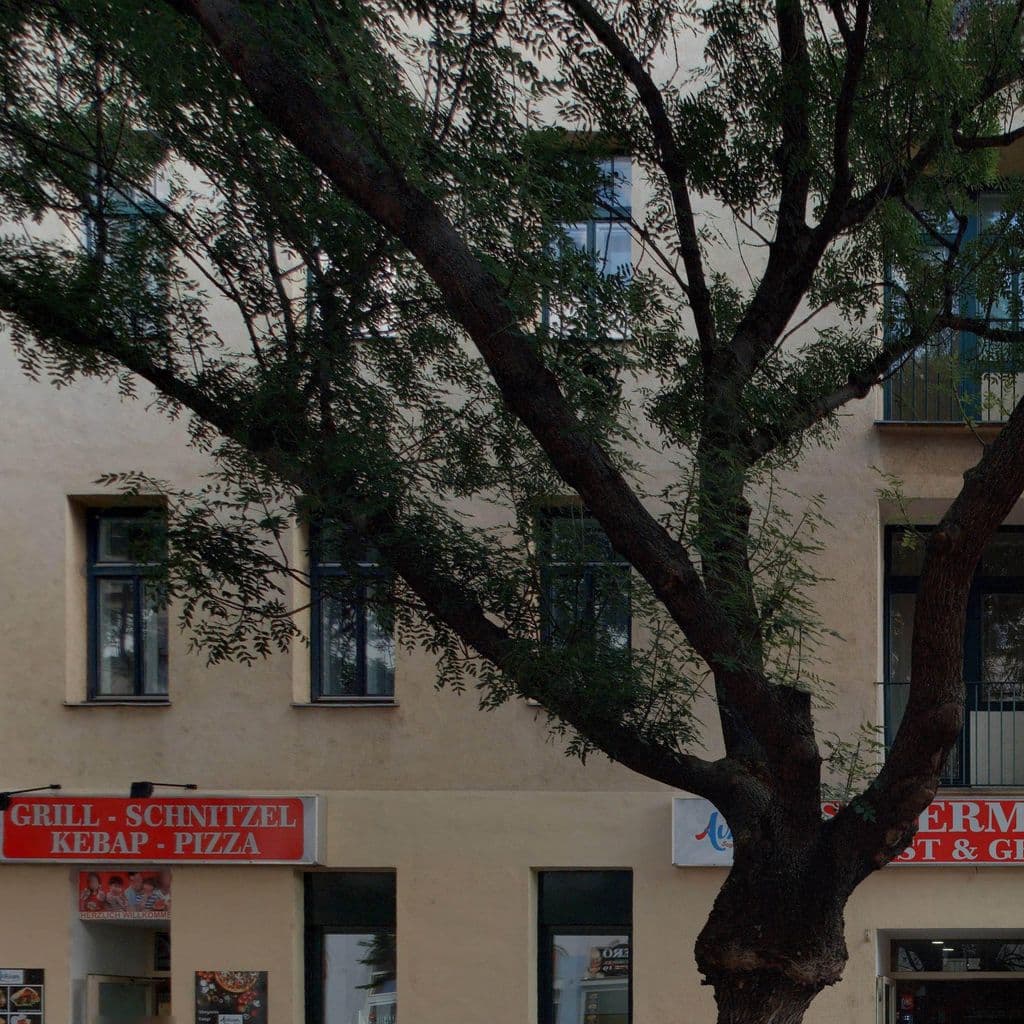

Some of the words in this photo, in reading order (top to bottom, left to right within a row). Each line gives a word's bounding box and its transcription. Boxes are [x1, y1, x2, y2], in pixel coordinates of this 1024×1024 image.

[10, 803, 100, 827] GRILL
[125, 803, 297, 829] SCHNITZEL
[50, 831, 149, 854] KEBAP
[173, 831, 261, 855] PIZZA
[951, 838, 979, 861] &
